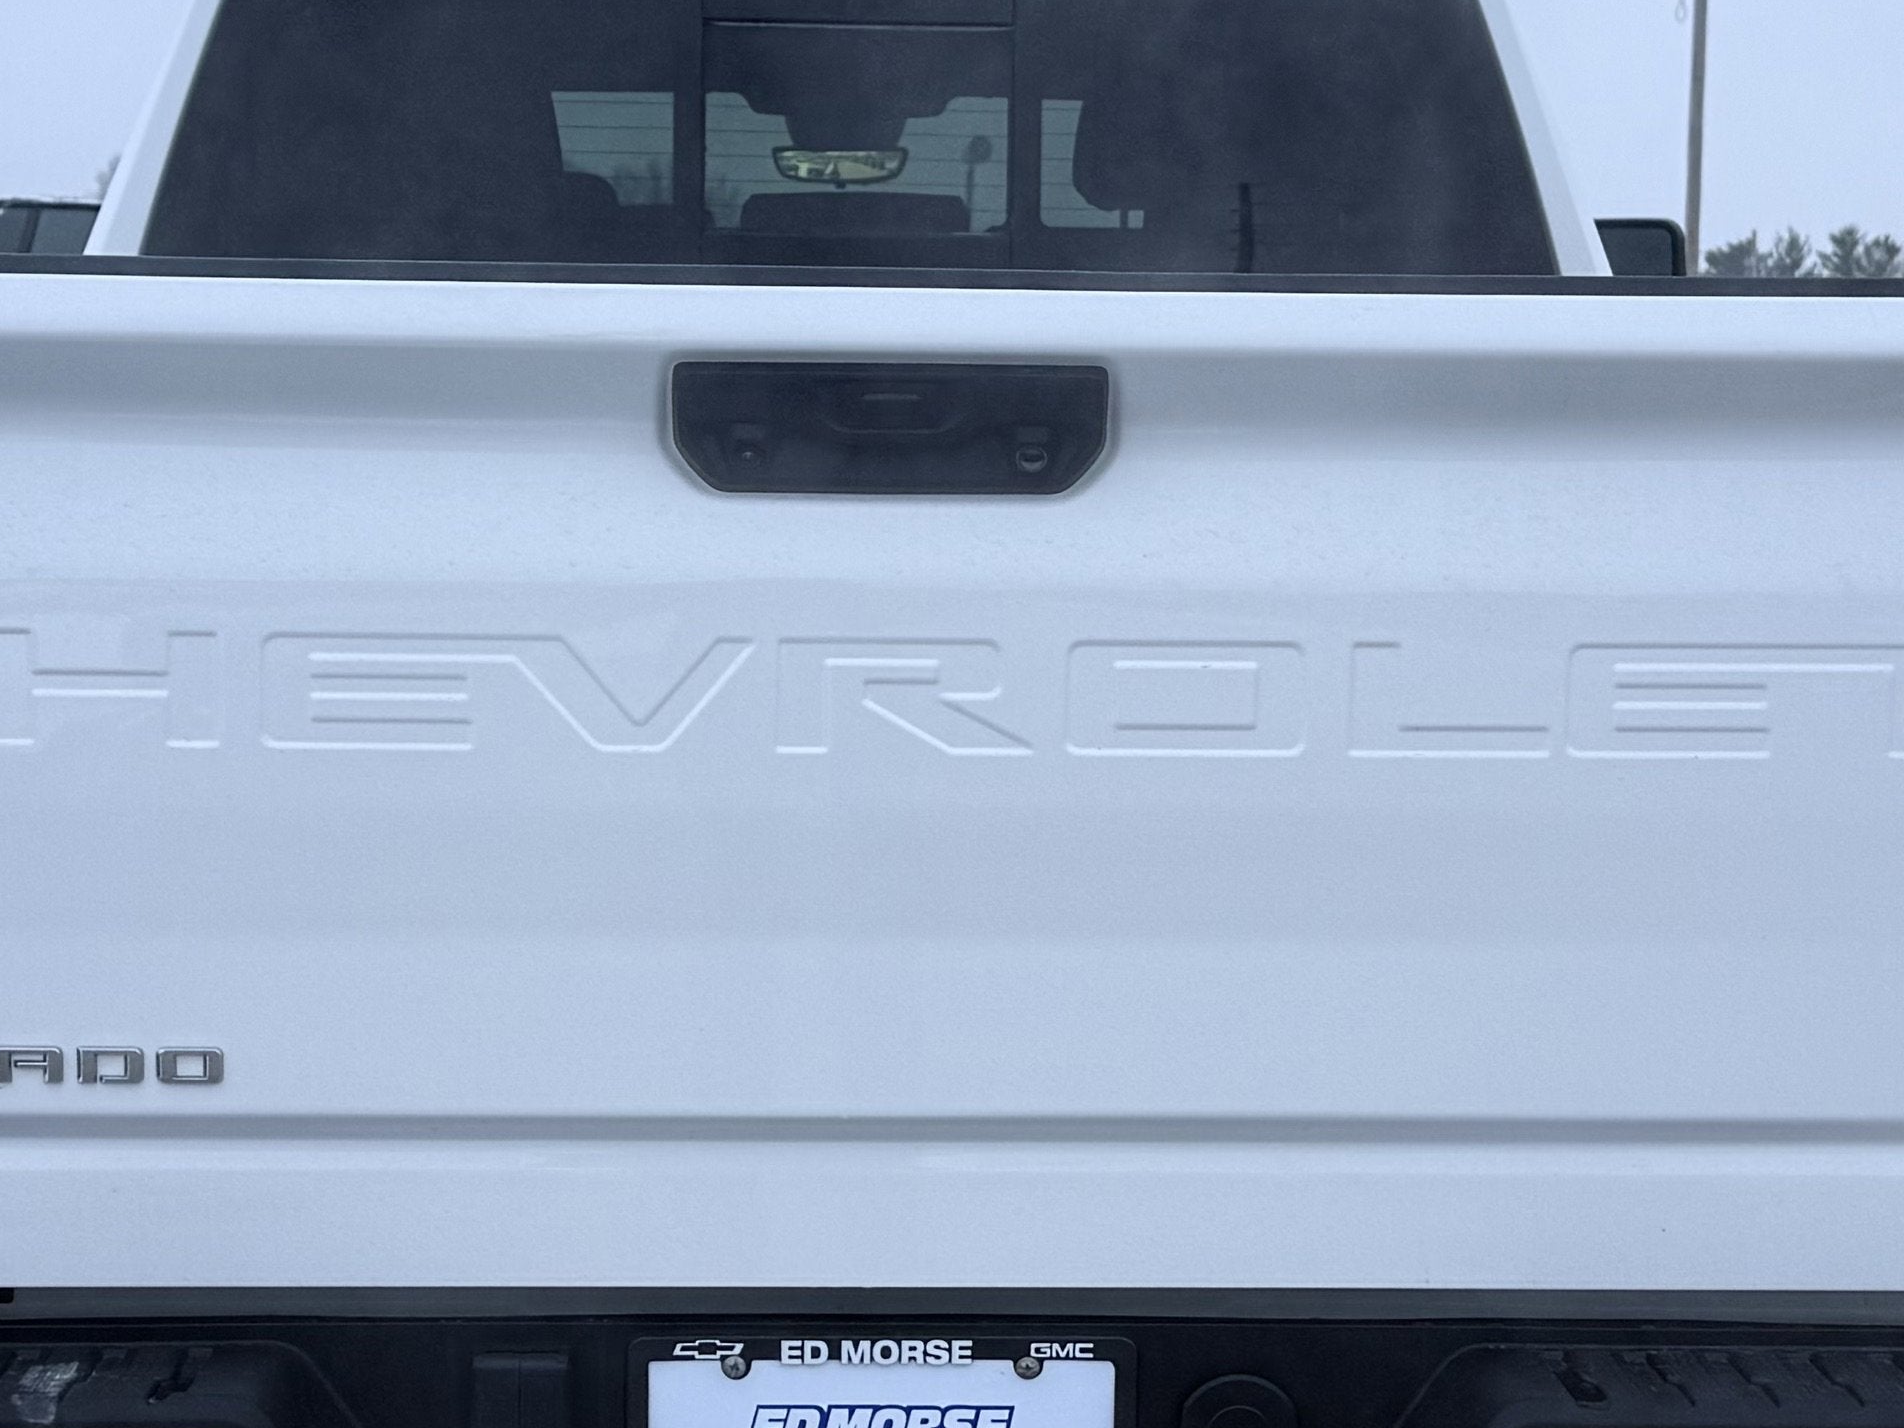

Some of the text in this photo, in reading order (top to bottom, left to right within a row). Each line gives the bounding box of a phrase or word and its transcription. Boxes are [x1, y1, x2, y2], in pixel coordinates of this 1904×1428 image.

[780, 1339, 973, 1365] ED MORSE
[1030, 1342, 1095, 1359] GMC
